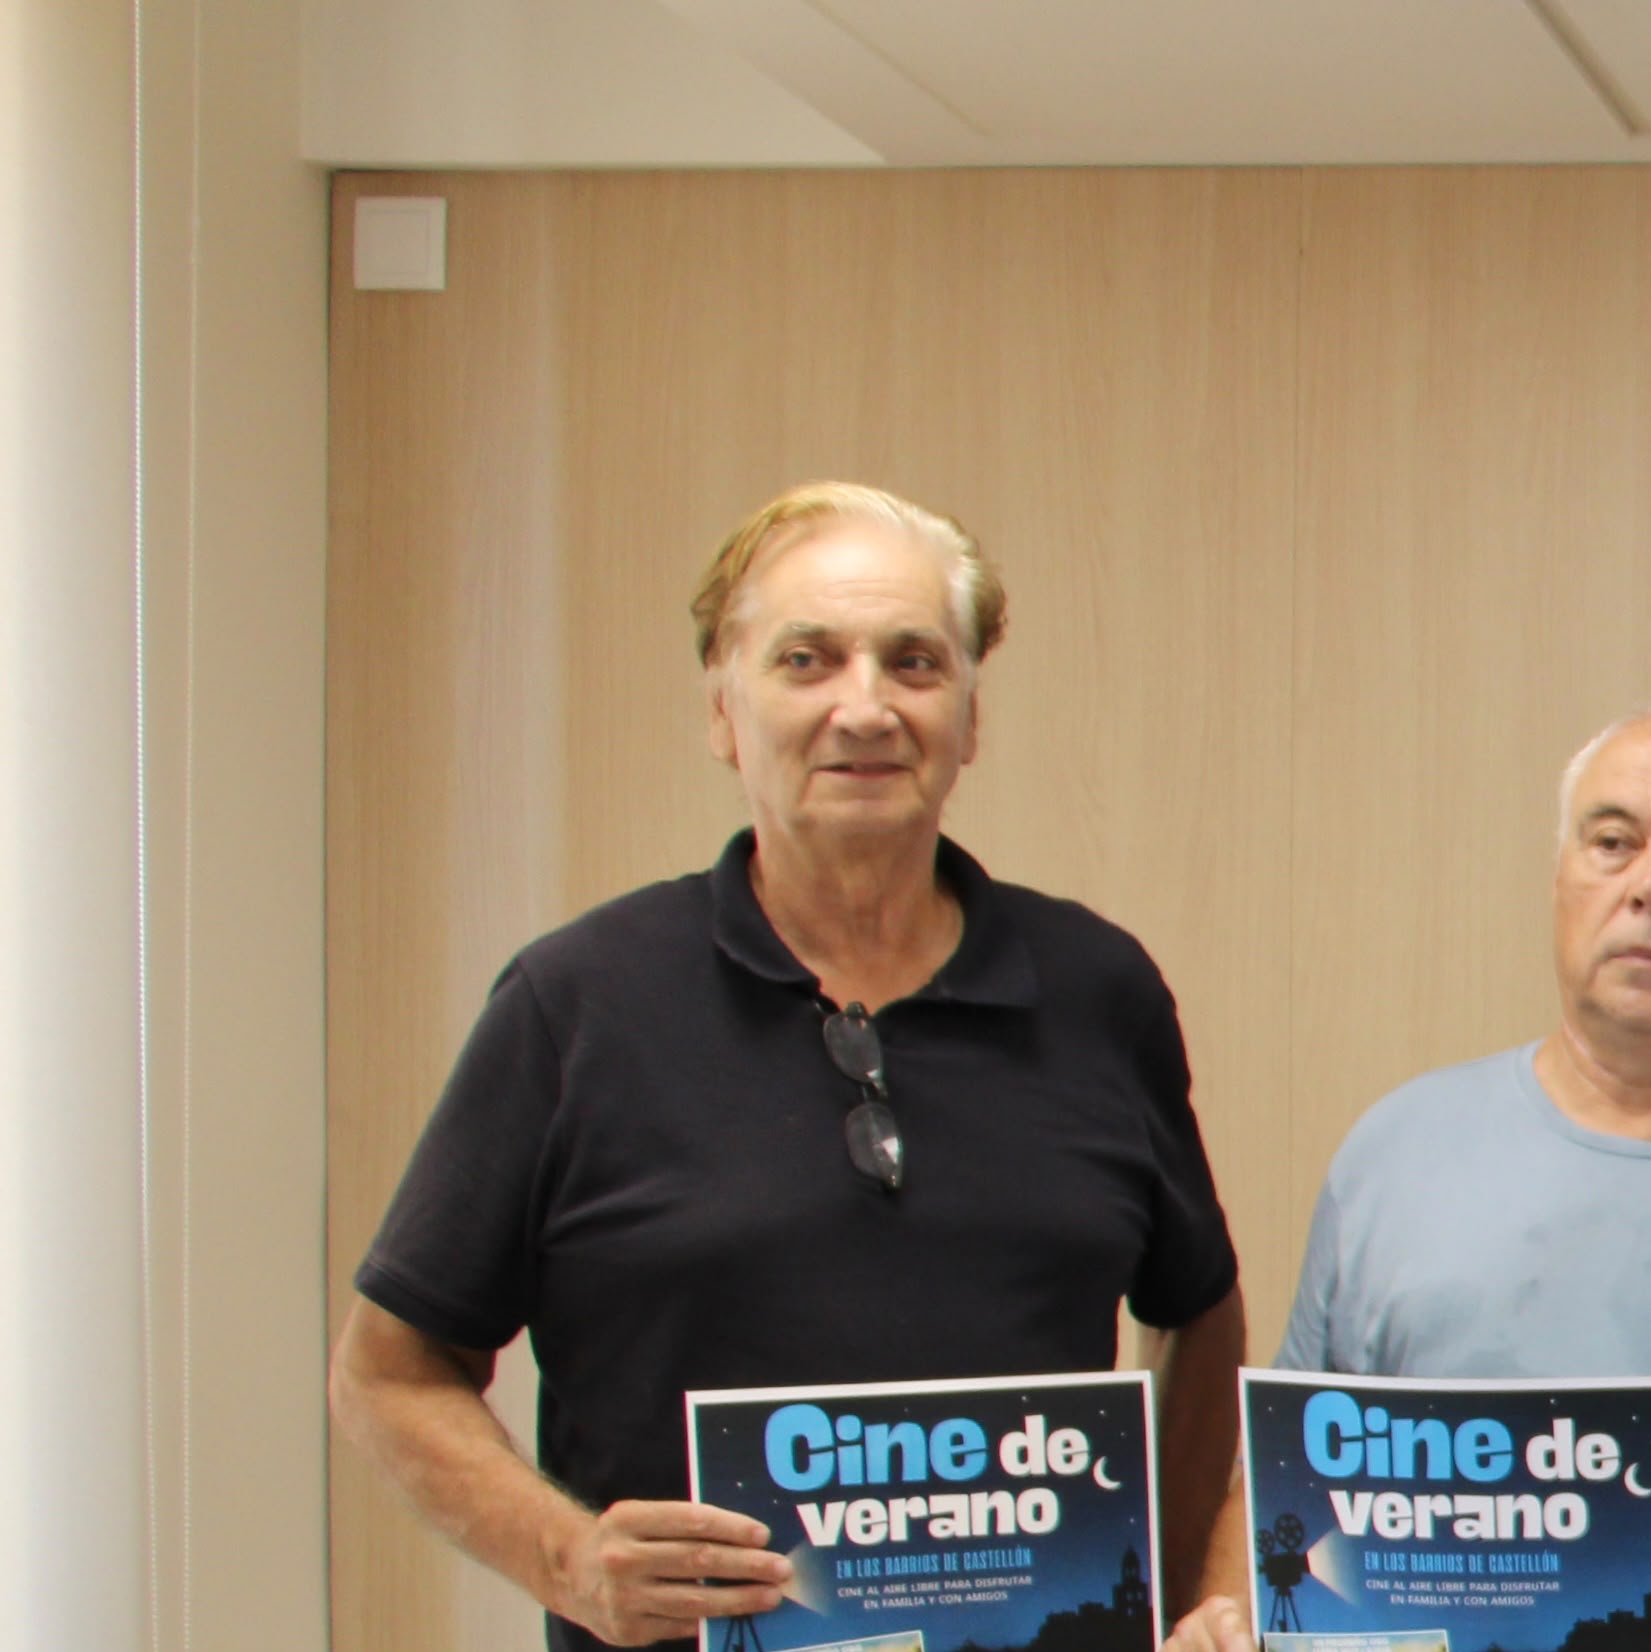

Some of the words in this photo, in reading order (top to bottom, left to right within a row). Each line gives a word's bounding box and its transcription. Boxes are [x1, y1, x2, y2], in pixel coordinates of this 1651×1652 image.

[765, 1404, 988, 1491] Cine
[1000, 1415, 1089, 1476] de
[1303, 1391, 1513, 1482] Cine
[1526, 1418, 1621, 1481] de
[797, 1488, 1060, 1547] verano
[1329, 1490, 1589, 1541] verano
